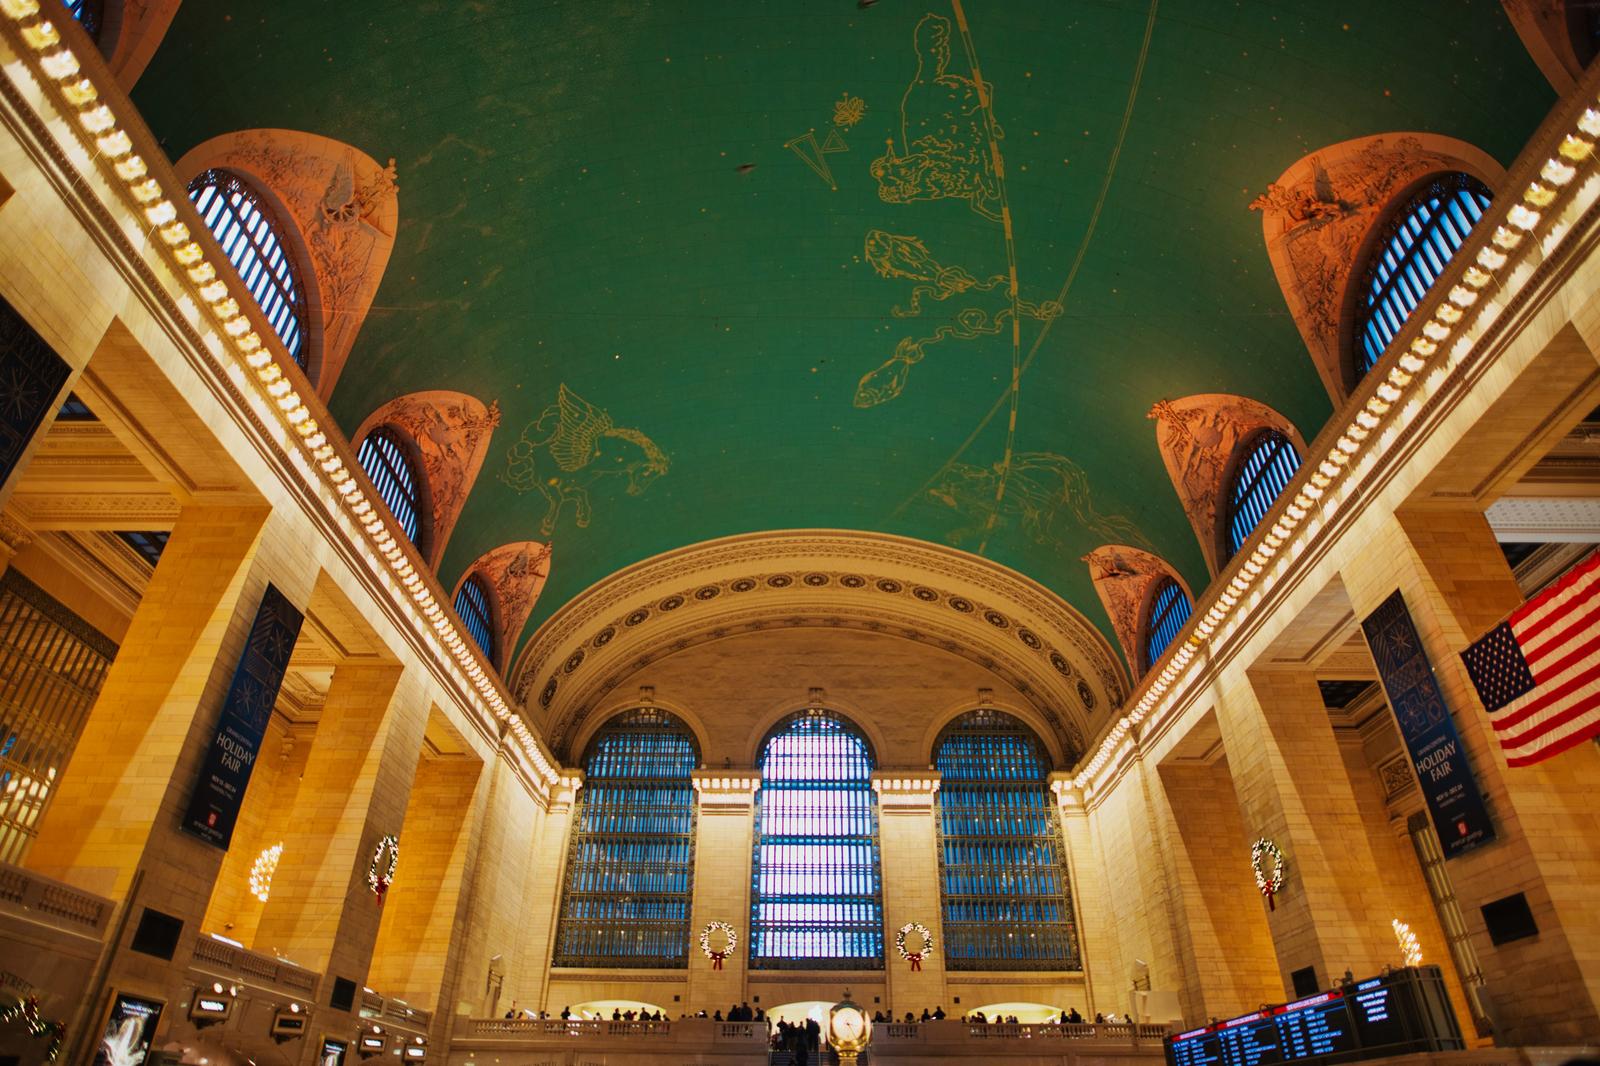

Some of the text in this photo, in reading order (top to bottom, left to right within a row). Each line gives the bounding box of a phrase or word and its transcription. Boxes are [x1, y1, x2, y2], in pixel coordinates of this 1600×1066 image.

[216, 732, 255, 766] HOLIDAY
[221, 751, 241, 774] FAIR
[1416, 739, 1457, 775] HOLIDAY
[1430, 761, 1453, 782] FAIR
